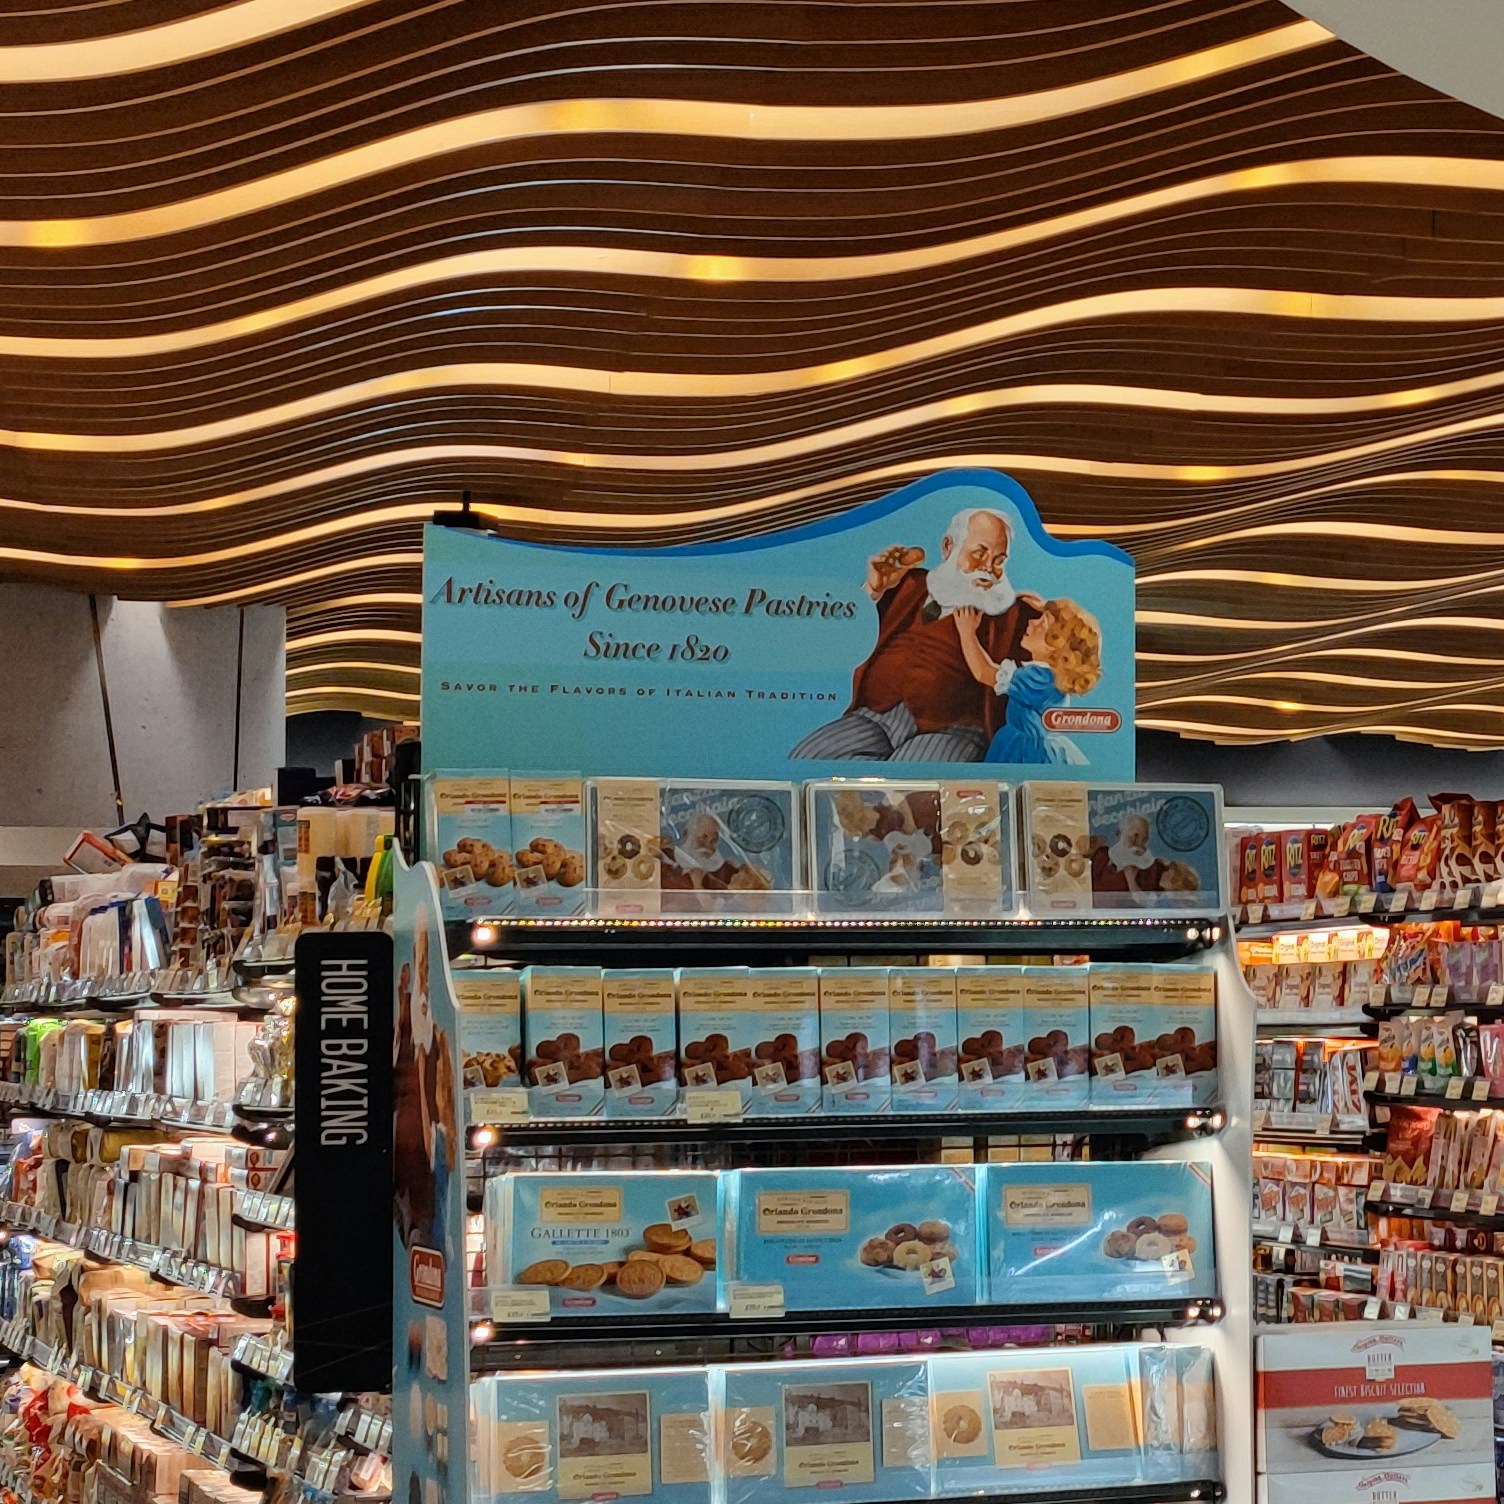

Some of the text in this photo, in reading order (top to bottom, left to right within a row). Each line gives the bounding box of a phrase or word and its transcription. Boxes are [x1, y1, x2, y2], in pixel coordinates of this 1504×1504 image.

[429, 576, 857, 621] Artisans of Genovese Pastries
[583, 631, 730, 664] Since 1820
[440, 681, 837, 701] SAVOR THE FLAVORS OF ITALIAN TRADITION
[1051, 711, 1112, 729] Grondona
[1310, 833, 1326, 846] RITZ
[1410, 831, 1428, 849] RITZ
[1260, 843, 1276, 871] RITZ
[1286, 841, 1303, 871] RITZ
[320, 958, 369, 1147] HOME BAKING
[544, 1200, 617, 1209] Orlando Grondona
[531, 1227, 601, 1239] GALLETTE
[1390, 1382, 1425, 1395] SELECTION
